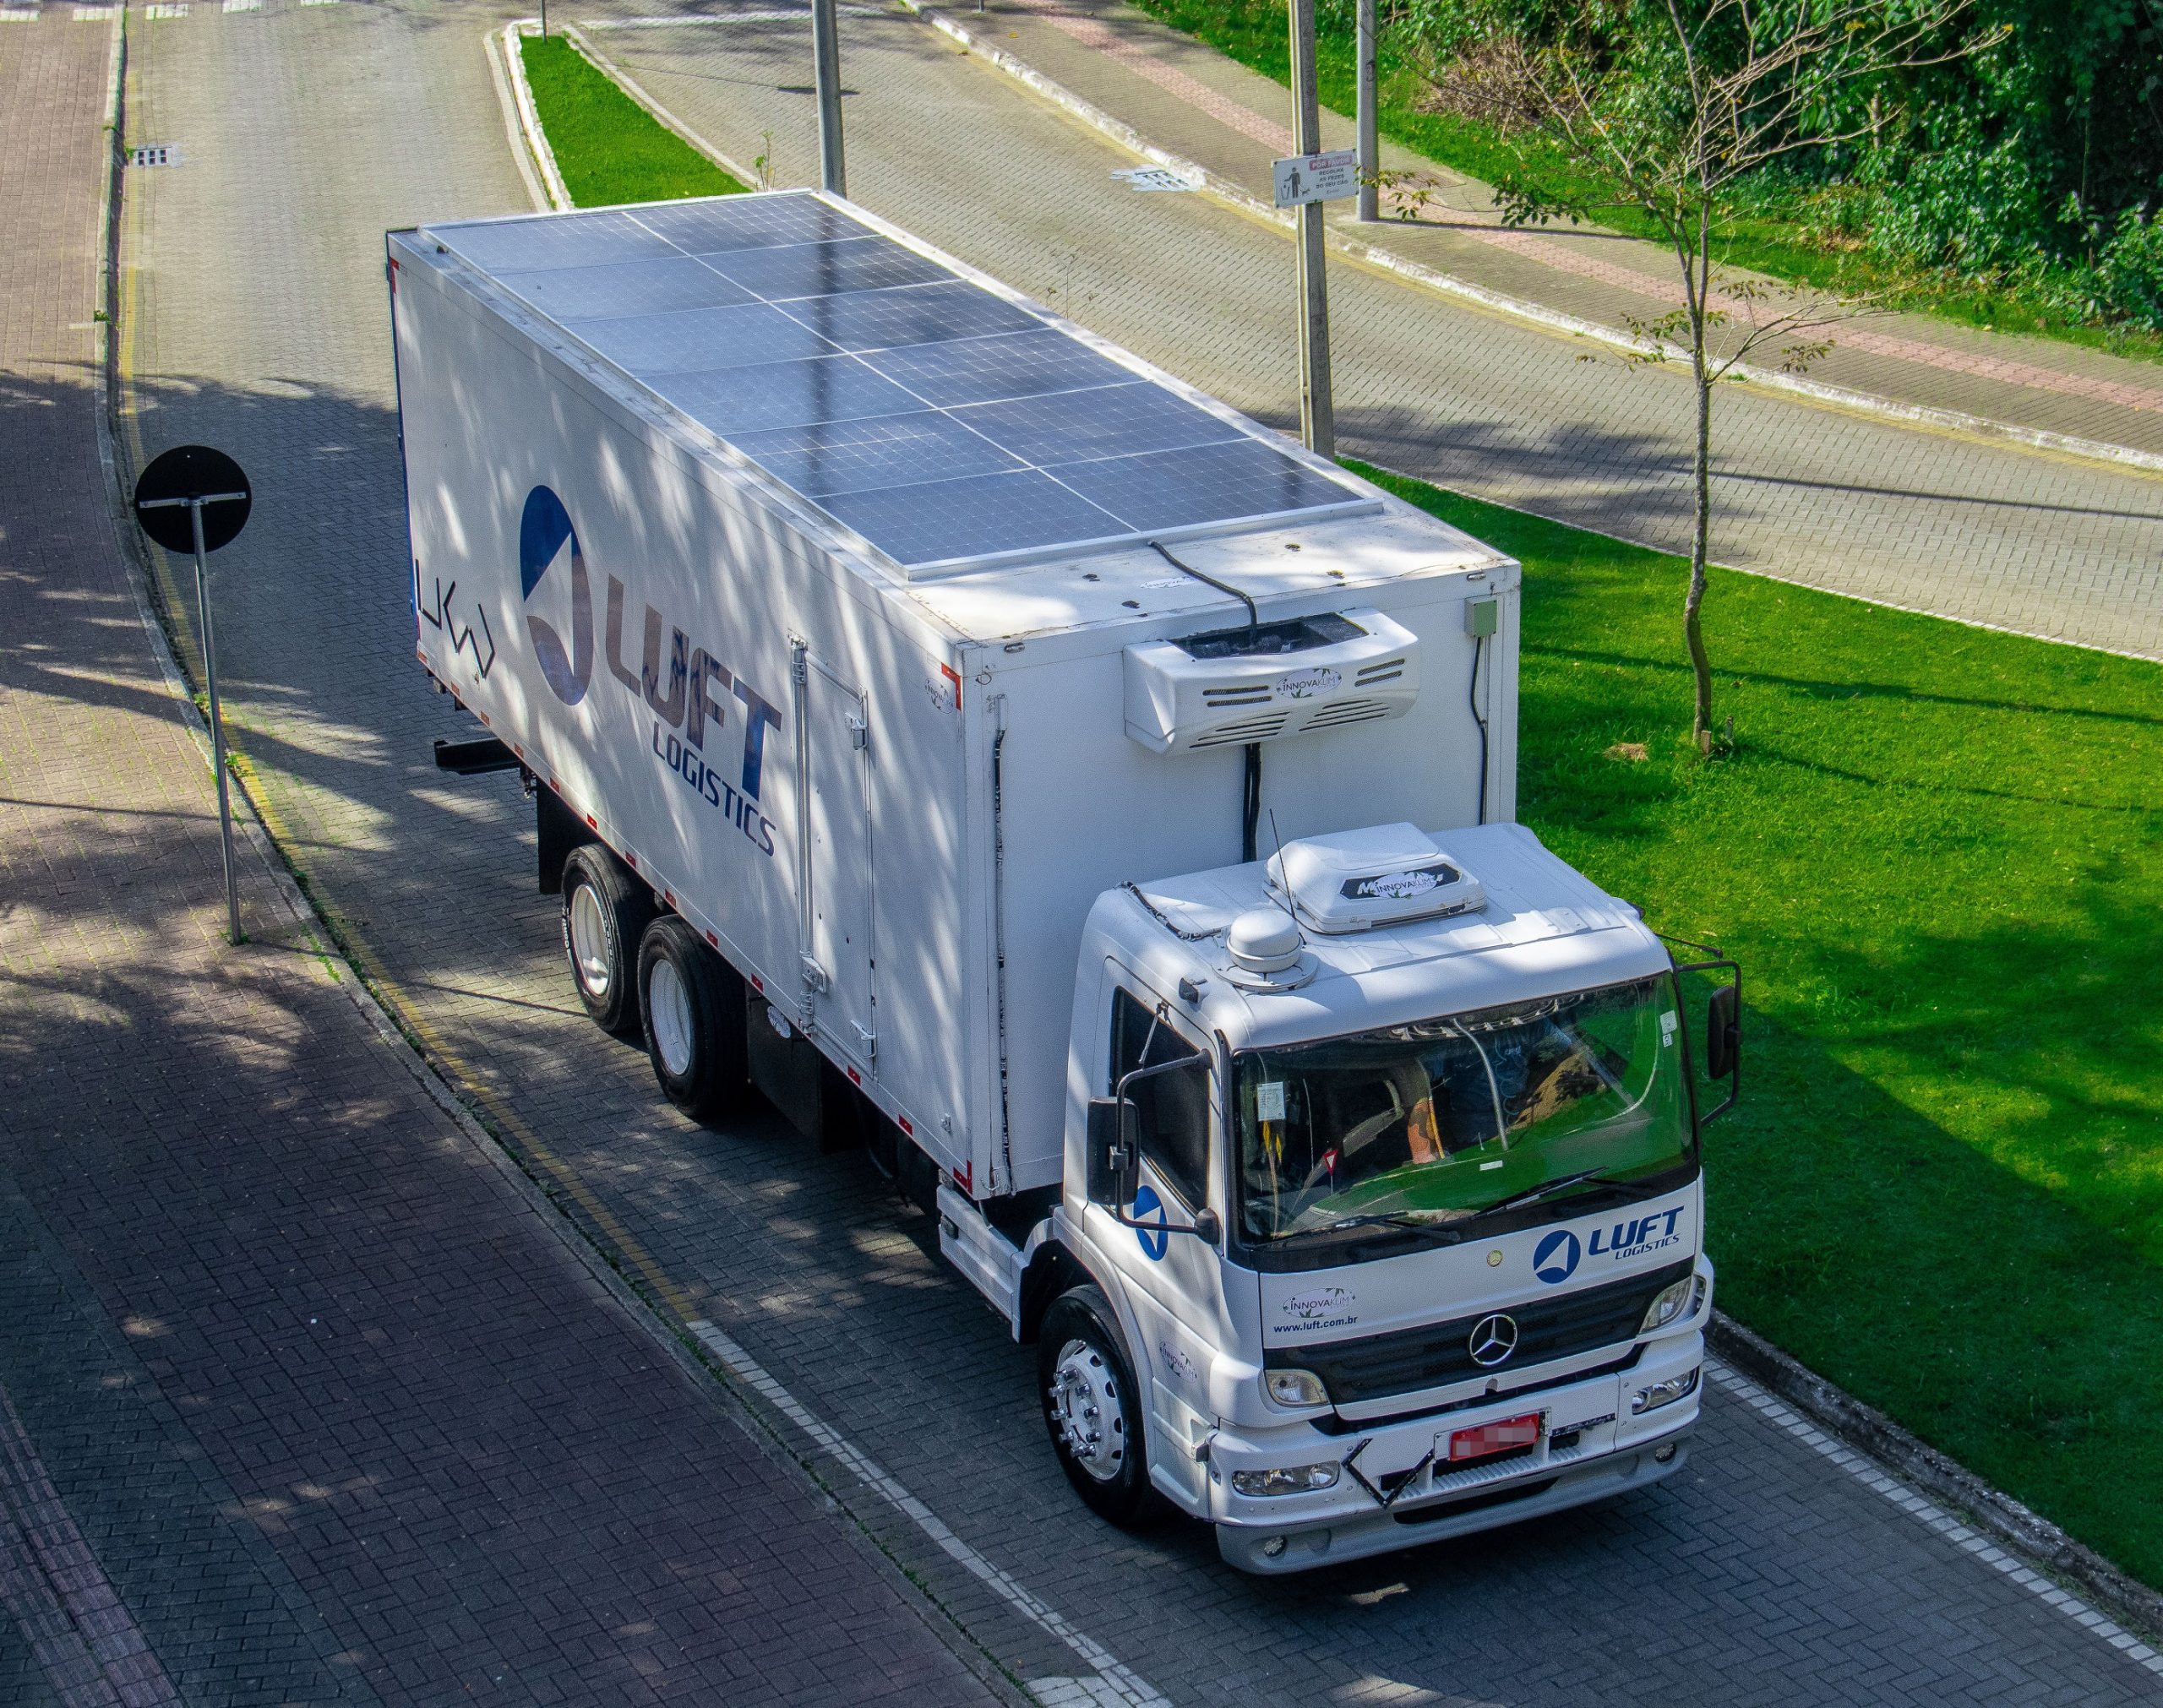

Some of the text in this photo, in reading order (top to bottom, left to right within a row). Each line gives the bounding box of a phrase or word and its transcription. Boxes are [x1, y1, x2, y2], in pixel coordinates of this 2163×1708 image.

[1319, 167, 1344, 176] RECOLHA
[605, 573, 782, 801] LUFT
[653, 721, 776, 857] LOGISTICS
[1588, 1205, 1685, 1256] LUFT
[1615, 1232, 1681, 1260] LOGISTICS
[1273, 1315, 1359, 1333] www.luft.com.br
